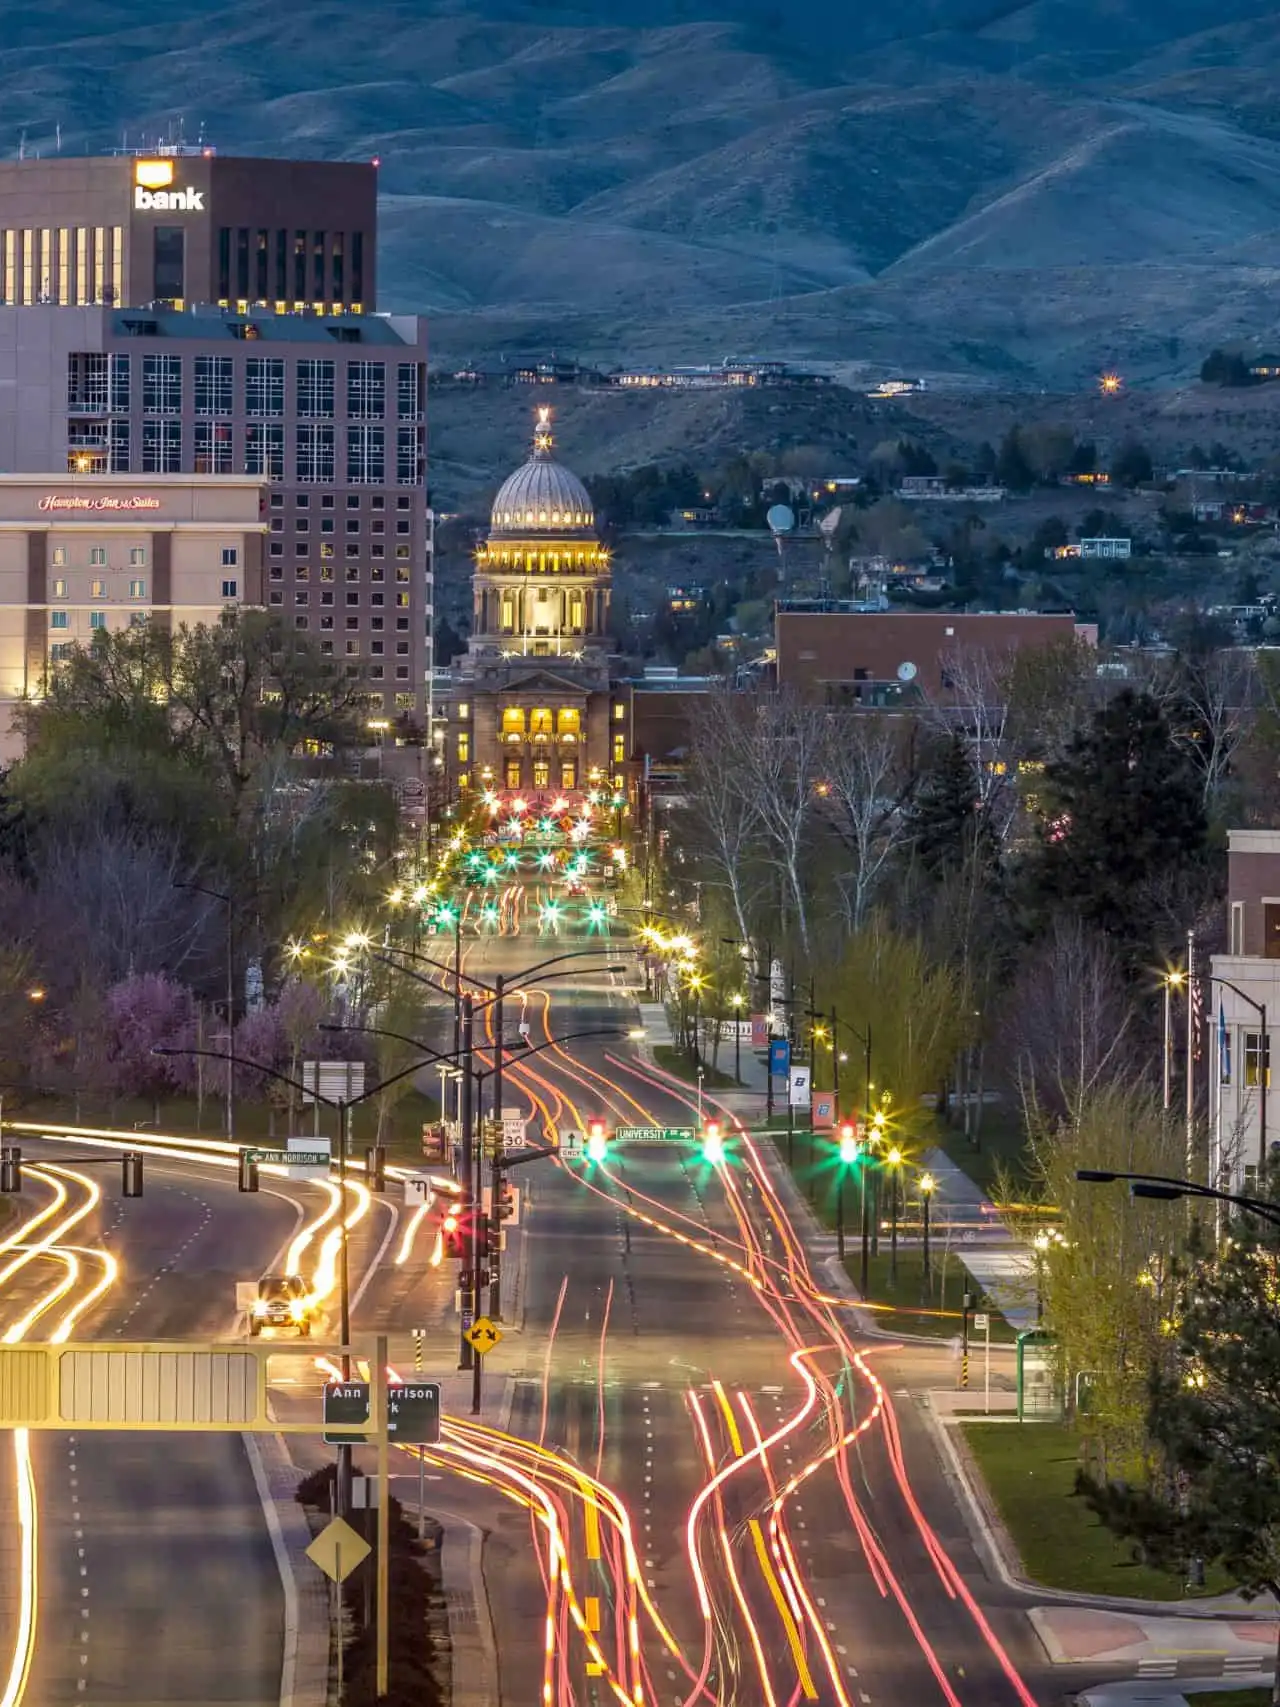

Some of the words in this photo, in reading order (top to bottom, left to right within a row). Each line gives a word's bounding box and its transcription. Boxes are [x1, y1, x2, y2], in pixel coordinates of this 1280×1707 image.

[134, 186, 205, 210] bank
[38, 495, 94, 511] Hampton
[619, 1128, 667, 1139] UNIVERSITY
[505, 1136, 523, 1146] 30
[332, 1387, 361, 1399] Ann
[390, 1387, 434, 1399] rrison
